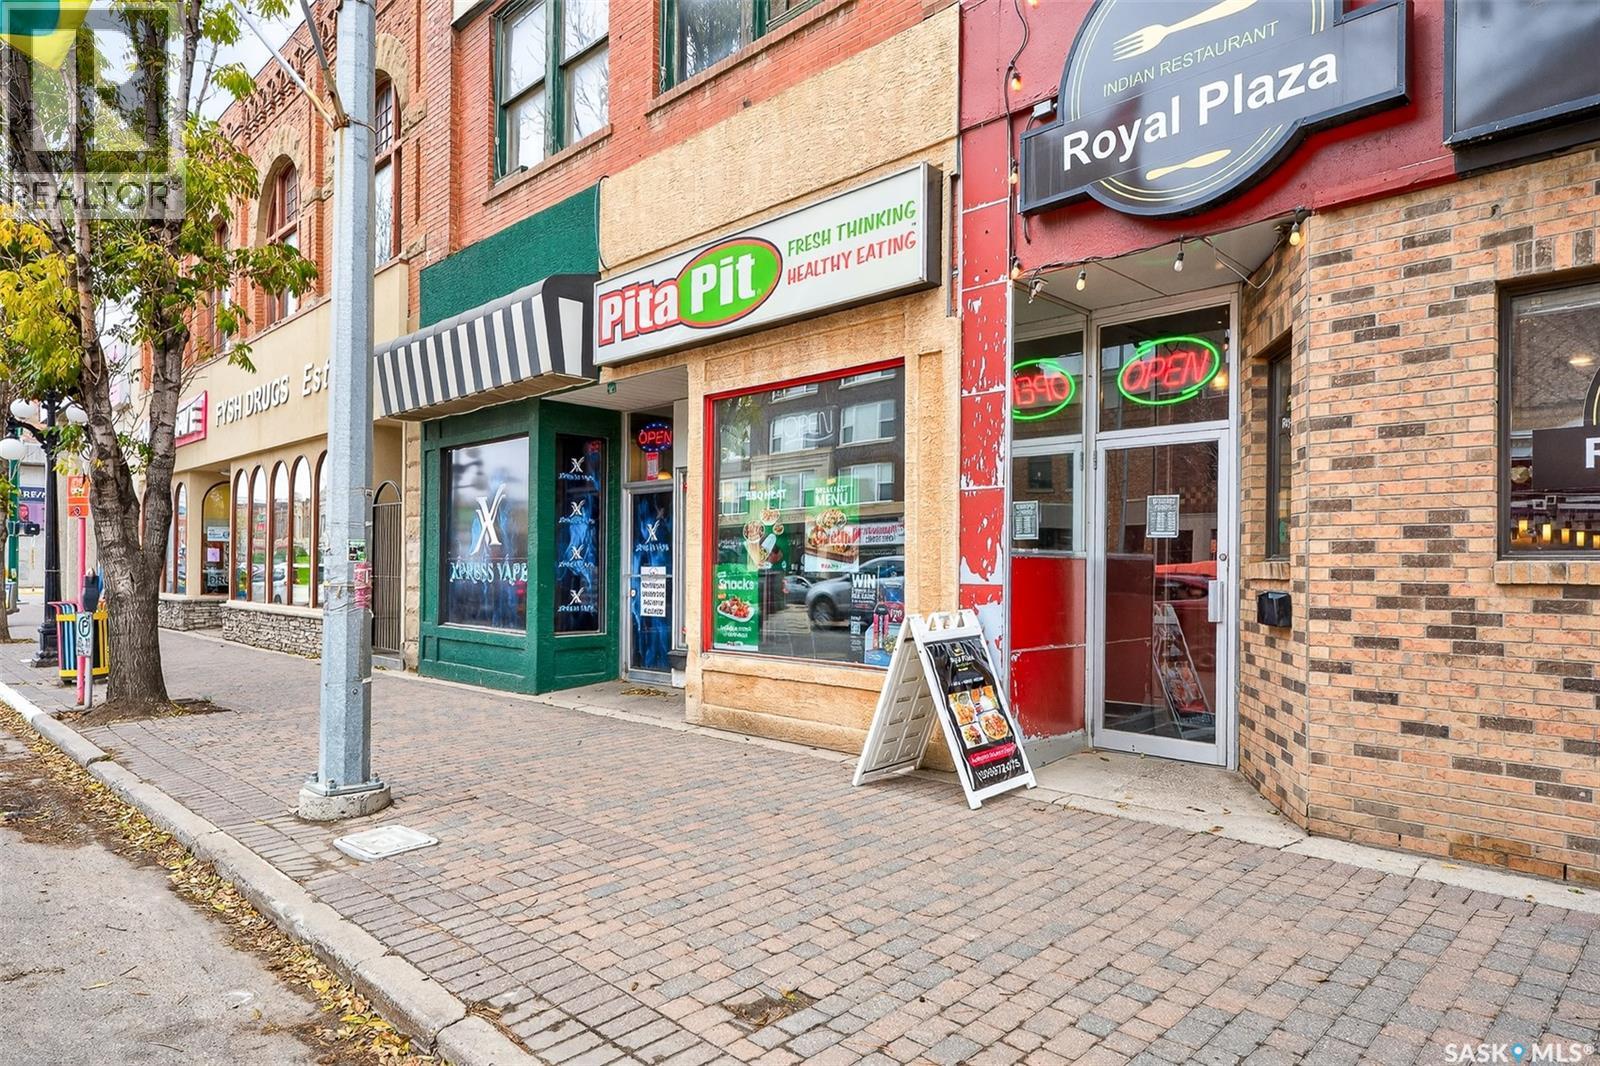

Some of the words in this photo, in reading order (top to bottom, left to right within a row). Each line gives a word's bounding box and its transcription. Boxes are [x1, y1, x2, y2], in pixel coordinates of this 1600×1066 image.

[1103, 66, 1155, 97] INDIAN
[1159, 20, 1280, 77] RESTAURANT
[1062, 95, 1180, 171] Royal
[1199, 53, 1338, 126] Plaza
[787, 228, 832, 257] FRESH
[836, 200, 917, 241] THINKING
[787, 250, 852, 285] HEALTHY
[856, 230, 917, 265] EATING
[600, 281, 679, 345] Pita
[690, 252, 757, 314] Pit
[1123, 349, 1211, 391] OPEN
[215, 394, 243, 427] FYSH
[245, 373, 290, 418] DRUGS
[638, 430, 673, 445] OPEN
[449, 555, 495, 584] XPRESS
[496, 553, 528, 586] VAPE
[851, 573, 876, 588] WIN
